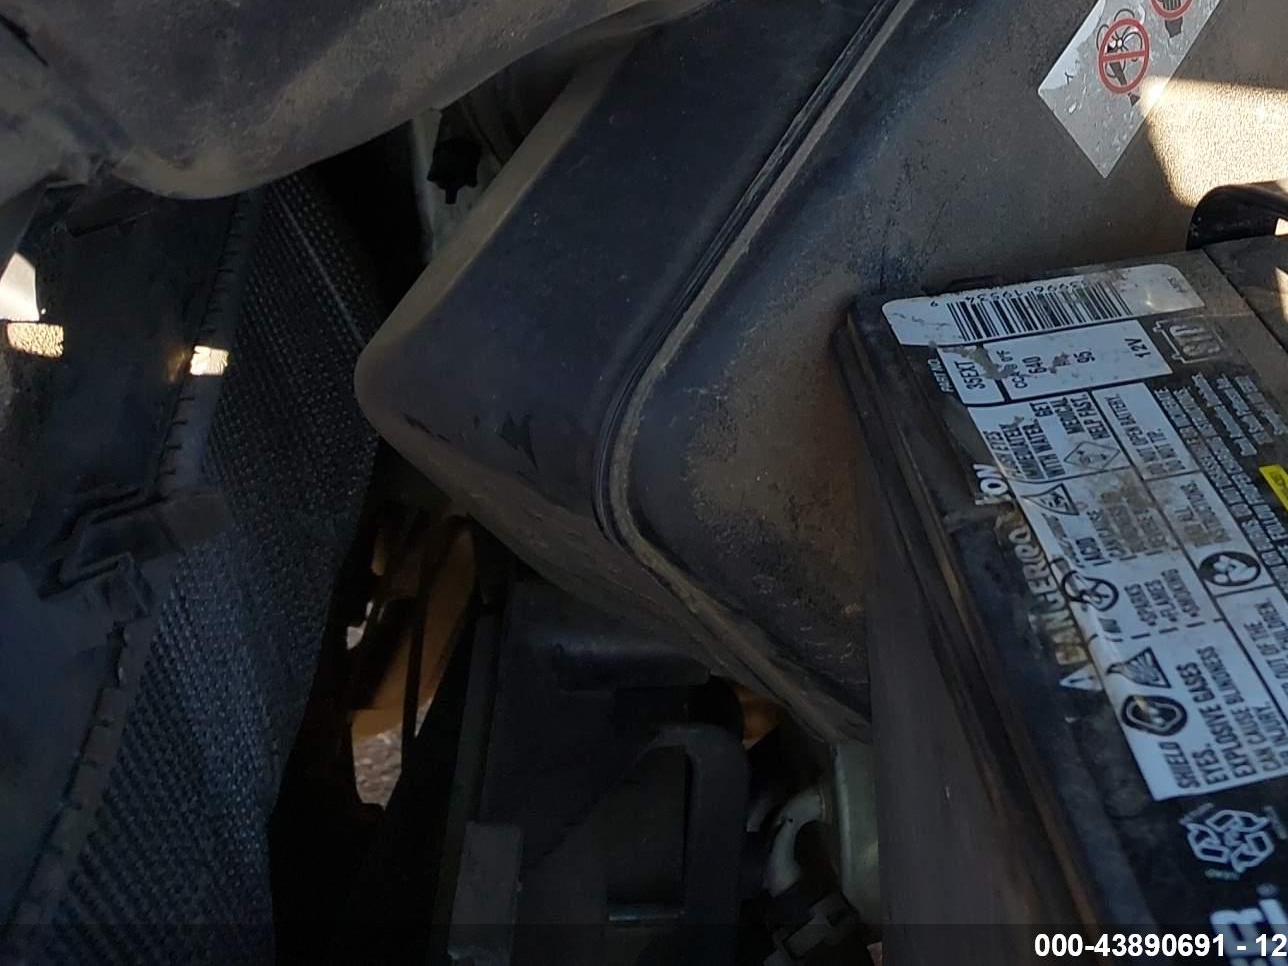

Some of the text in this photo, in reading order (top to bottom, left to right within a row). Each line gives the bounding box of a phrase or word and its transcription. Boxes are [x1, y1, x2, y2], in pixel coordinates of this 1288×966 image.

[1123, 336, 1153, 358] 12V
[953, 358, 986, 391] 35EXT
[1021, 355, 1047, 373] 640
[1029, 401, 1054, 417] GET
[1048, 397, 1085, 434] MEDICAL
[1068, 394, 1111, 439] HELP FAST.
[1036, 452, 1066, 477] WITH
[1242, 621, 1271, 642] THE
[1255, 640, 1280, 656] OF
[1194, 645, 1245, 705] BLINDNESS
[1174, 660, 1258, 778] EXPLOSIVE GASES
[1229, 706, 1268, 745] CAUSE
[1156, 739, 1200, 791] SHIELD
[1187, 742, 1229, 785] EYES.
[1252, 745, 1283, 772] CAN
